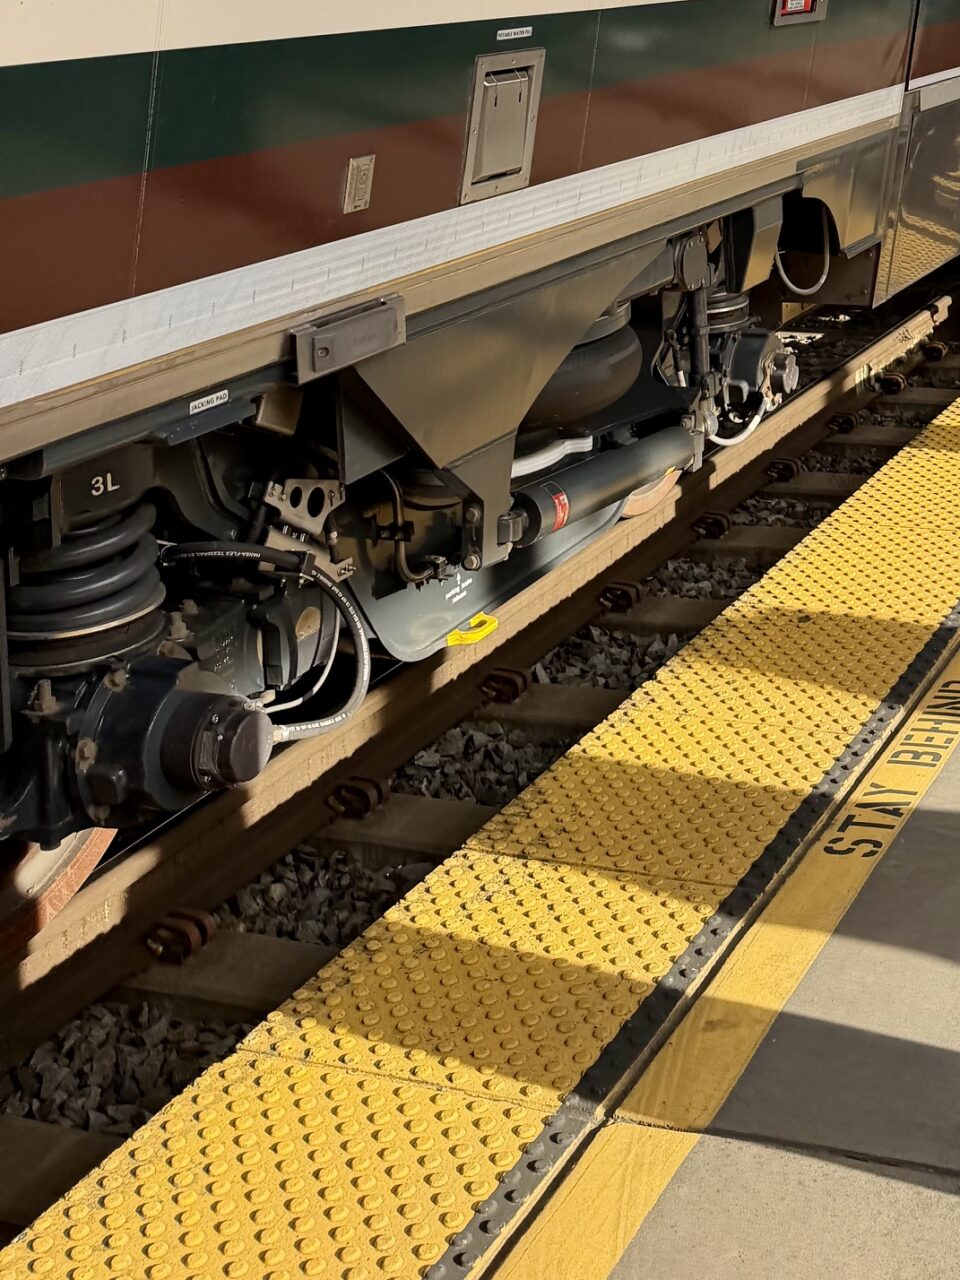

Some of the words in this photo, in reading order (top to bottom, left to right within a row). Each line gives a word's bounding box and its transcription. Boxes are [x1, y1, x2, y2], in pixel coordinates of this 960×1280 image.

[191, 397, 215, 412] JACKING
[215, 392, 228, 403] PAD
[91, 472, 121, 497] 3L
[823, 781, 919, 859] STAY
